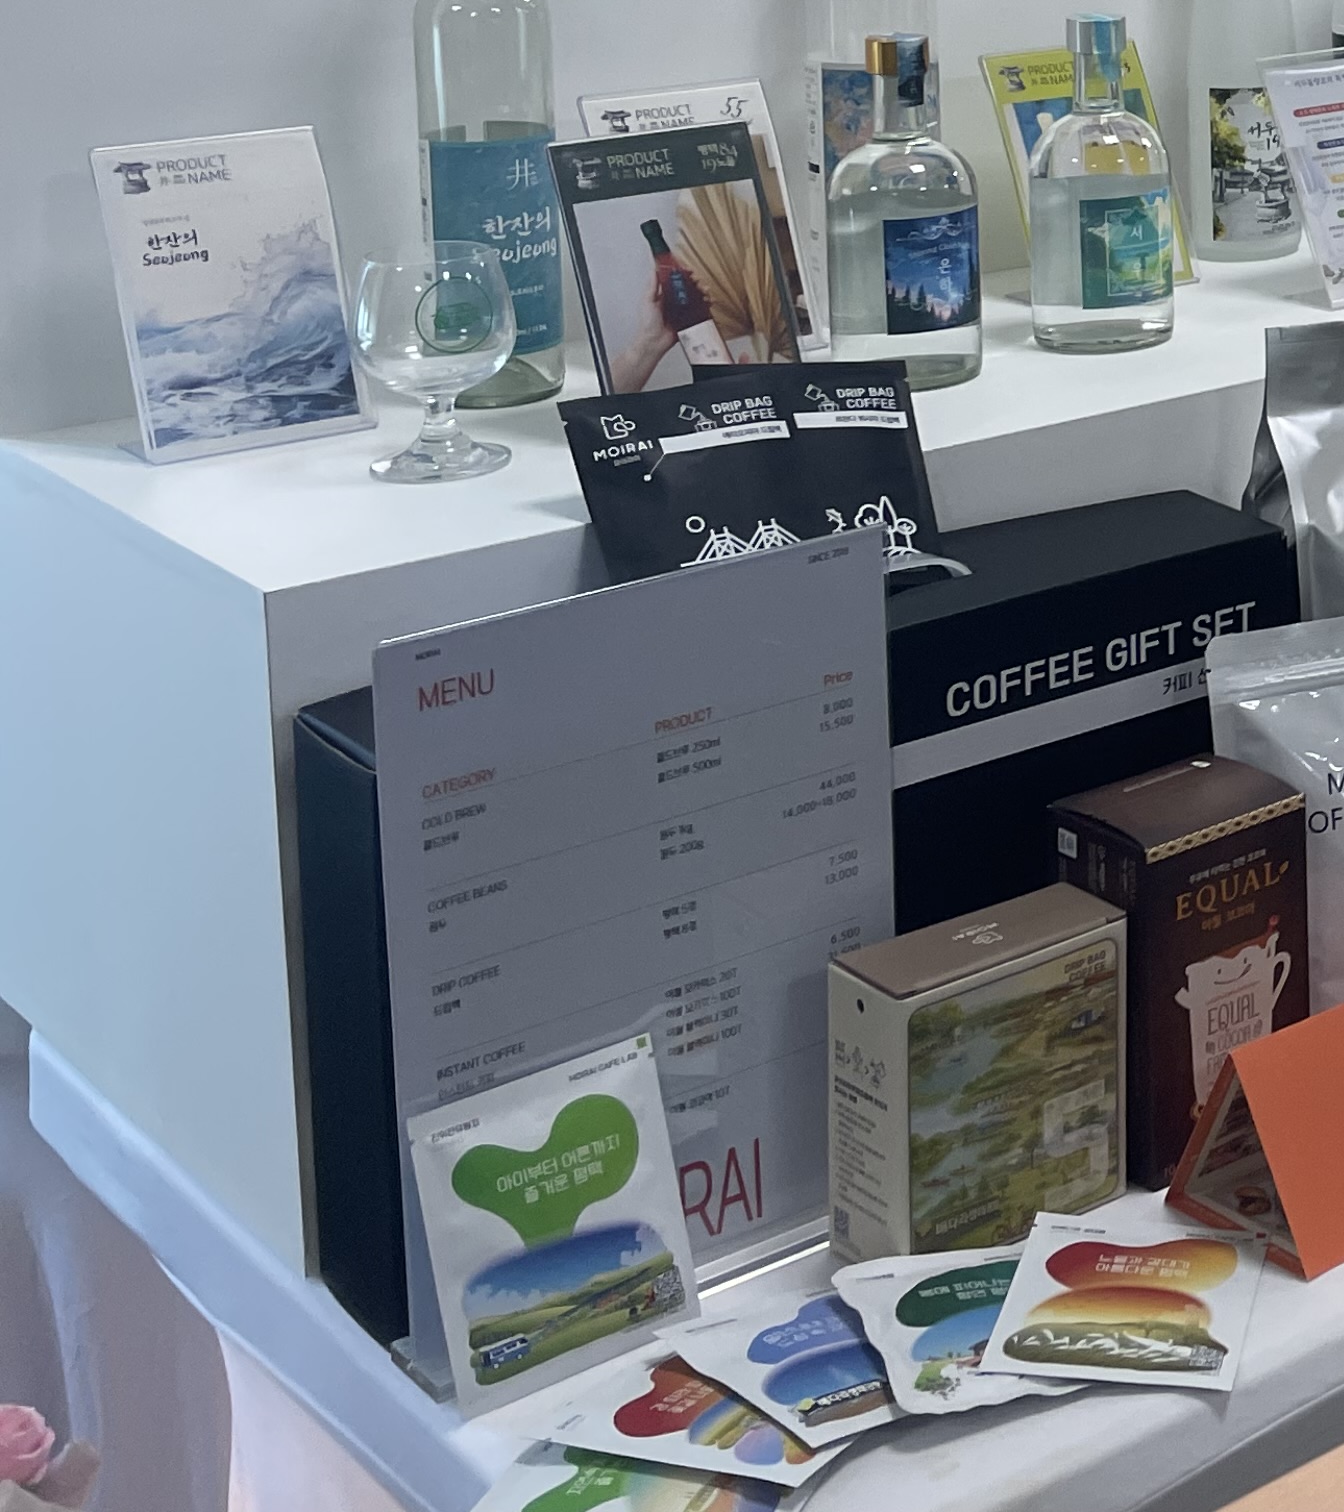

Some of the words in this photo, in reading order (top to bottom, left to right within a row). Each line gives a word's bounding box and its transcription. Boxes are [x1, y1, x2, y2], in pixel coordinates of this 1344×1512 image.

[1049, 74, 1074, 85] NAM
[635, 104, 691, 121] PRODUCT
[156, 153, 227, 174] PRODUCT
[606, 149, 670, 169] PRODUCT
[187, 167, 232, 184] NAME
[635, 163, 675, 179] NAME
[836, 387, 865, 398] DRIP
[868, 386, 896, 398] BAG
[711, 401, 741, 415] DRIP
[744, 396, 773, 410] BAG
[846, 397, 897, 410] COFFEE
[723, 407, 777, 425] COFFEE
[593, 439, 654, 462] MOIRAI
[946, 645, 1095, 718] COFFEE
[1106, 620, 1183, 672] GIFT
[1192, 602, 1256, 650] SET
[823, 671, 853, 686] Price
[418, 668, 495, 711] MENU
[654, 707, 712, 733] PRODUCT
[422, 768, 496, 799] CATEGORY
[1176, 860, 1281, 921] EQUAL
[1208, 993, 1260, 1035] EQUAL
[436, 1056, 481, 1081] INSTANT
[483, 1041, 526, 1066] COFFEE
[496, 1158, 558, 1194] 아이부터
